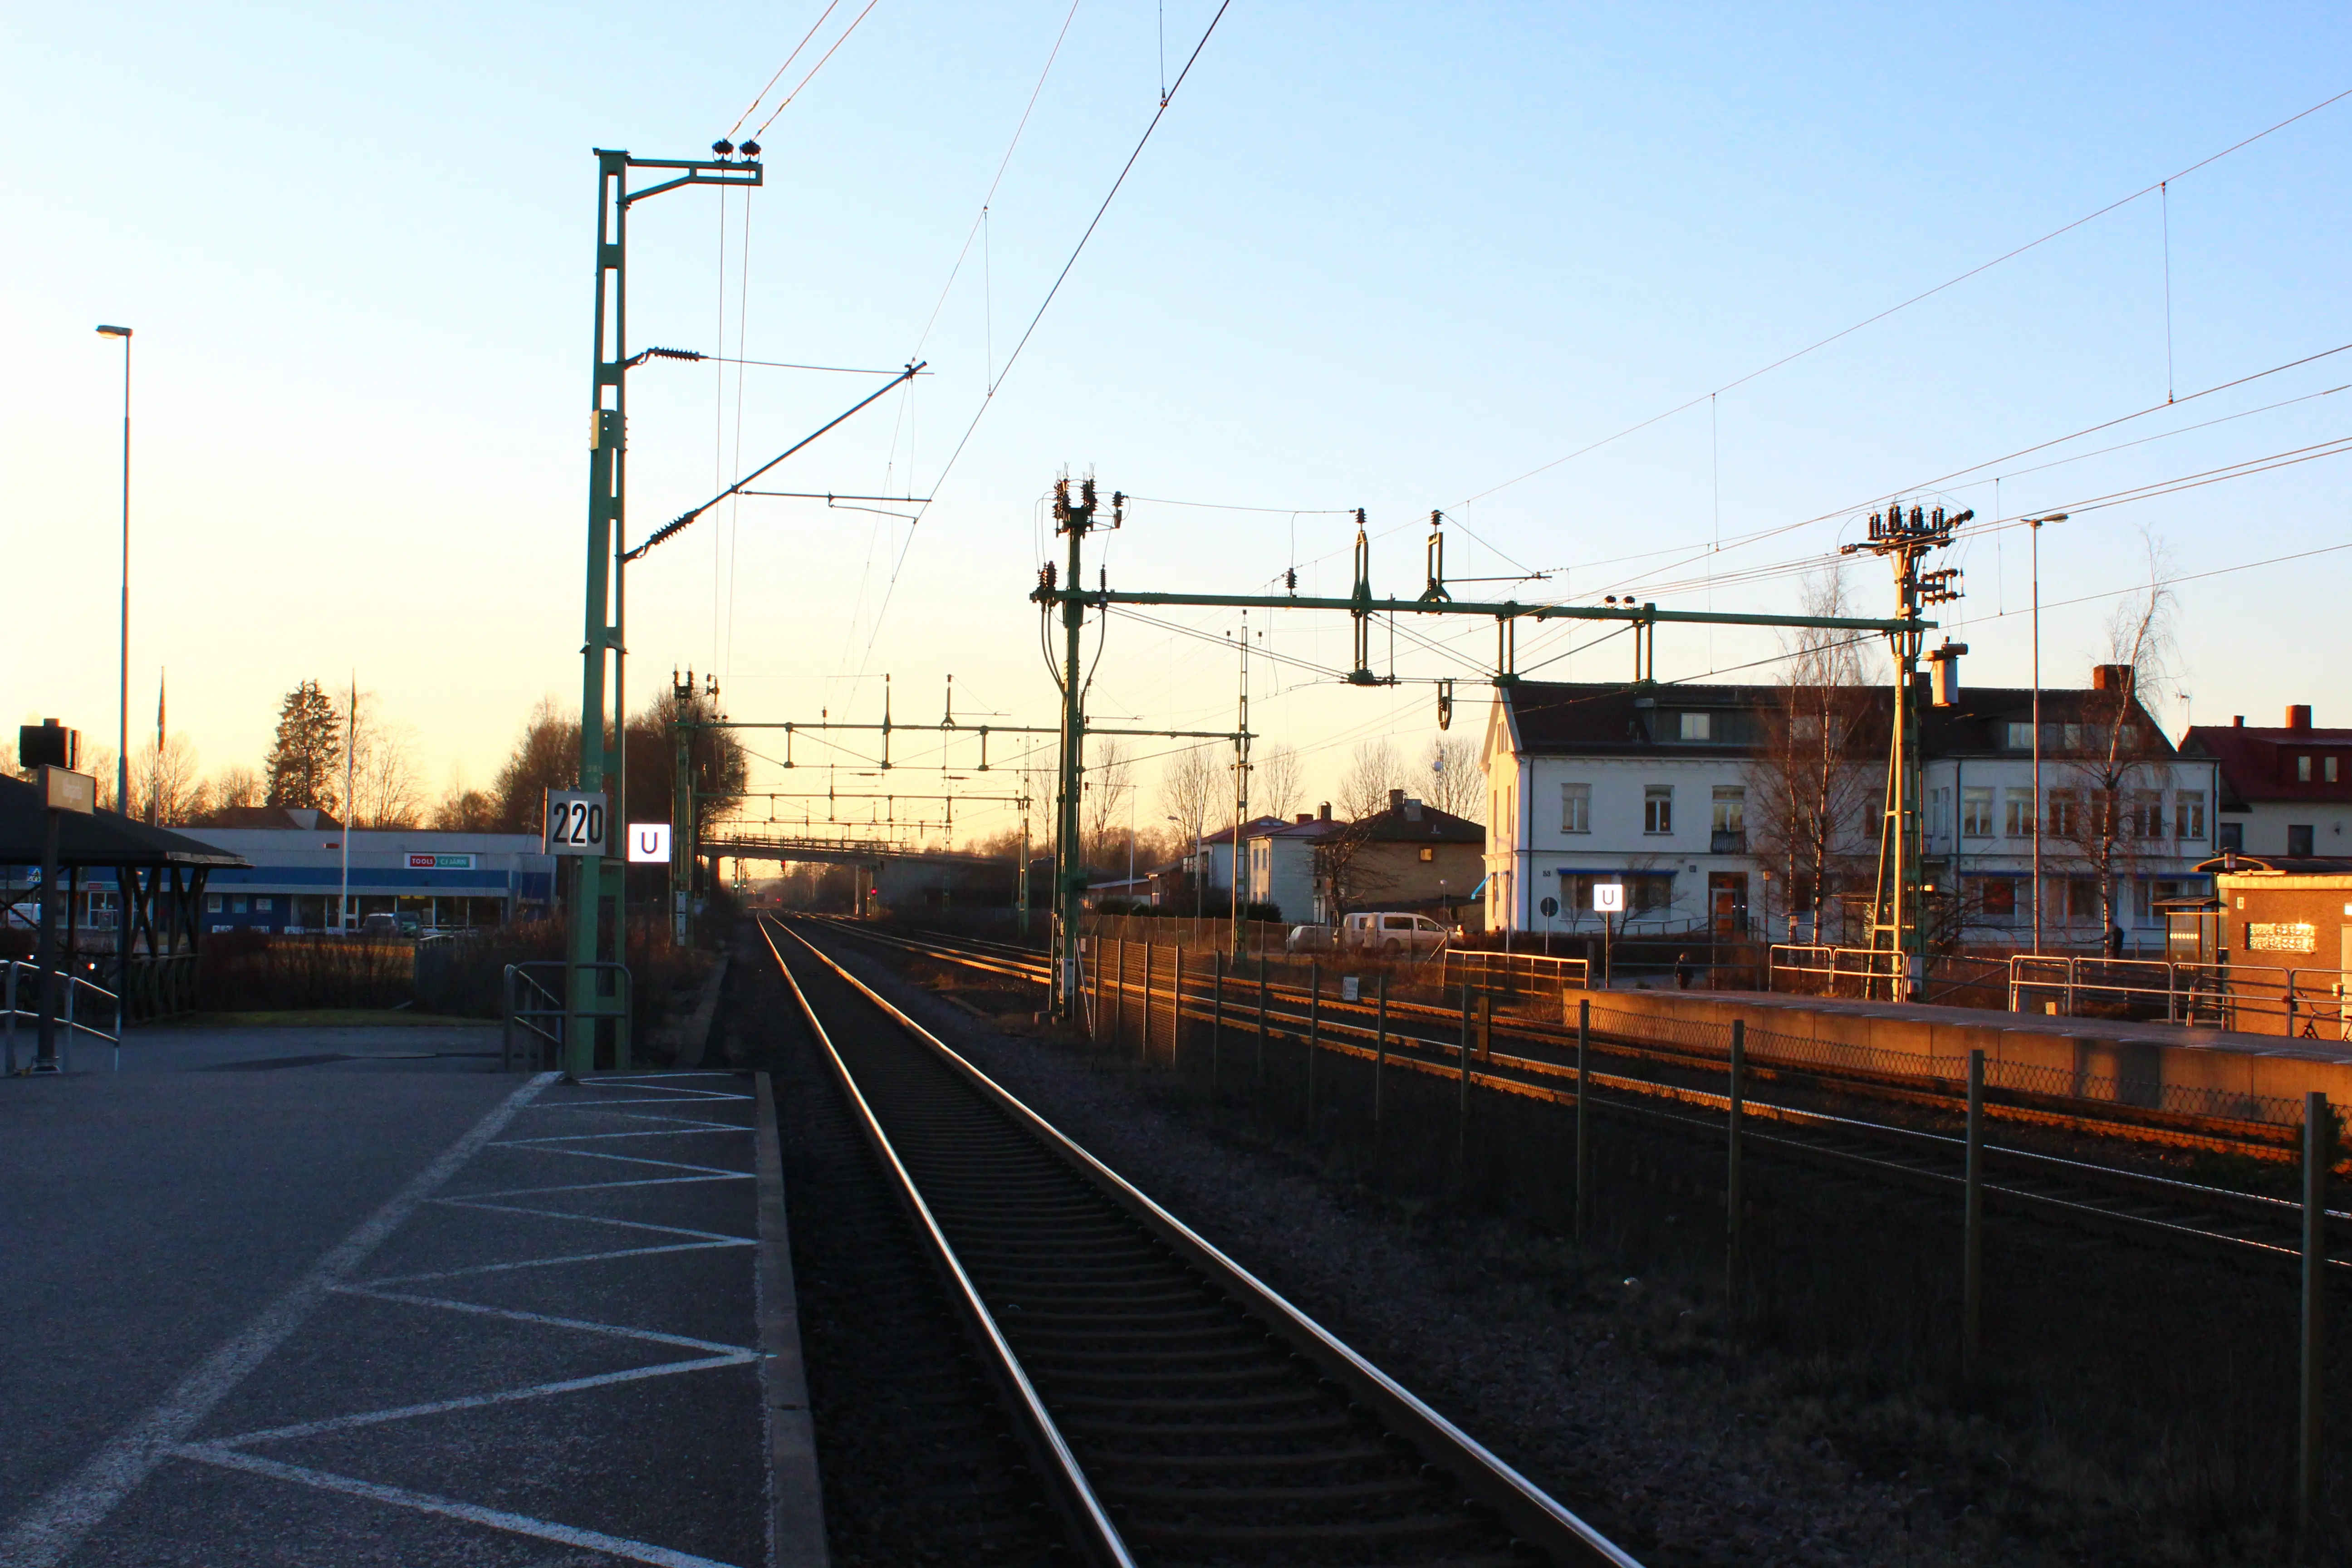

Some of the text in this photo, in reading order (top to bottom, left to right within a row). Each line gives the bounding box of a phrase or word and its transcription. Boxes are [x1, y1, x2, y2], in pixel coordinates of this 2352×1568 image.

[553, 803, 603, 844] 220
[641, 832, 658, 854] U
[1602, 890, 1614, 905] U
